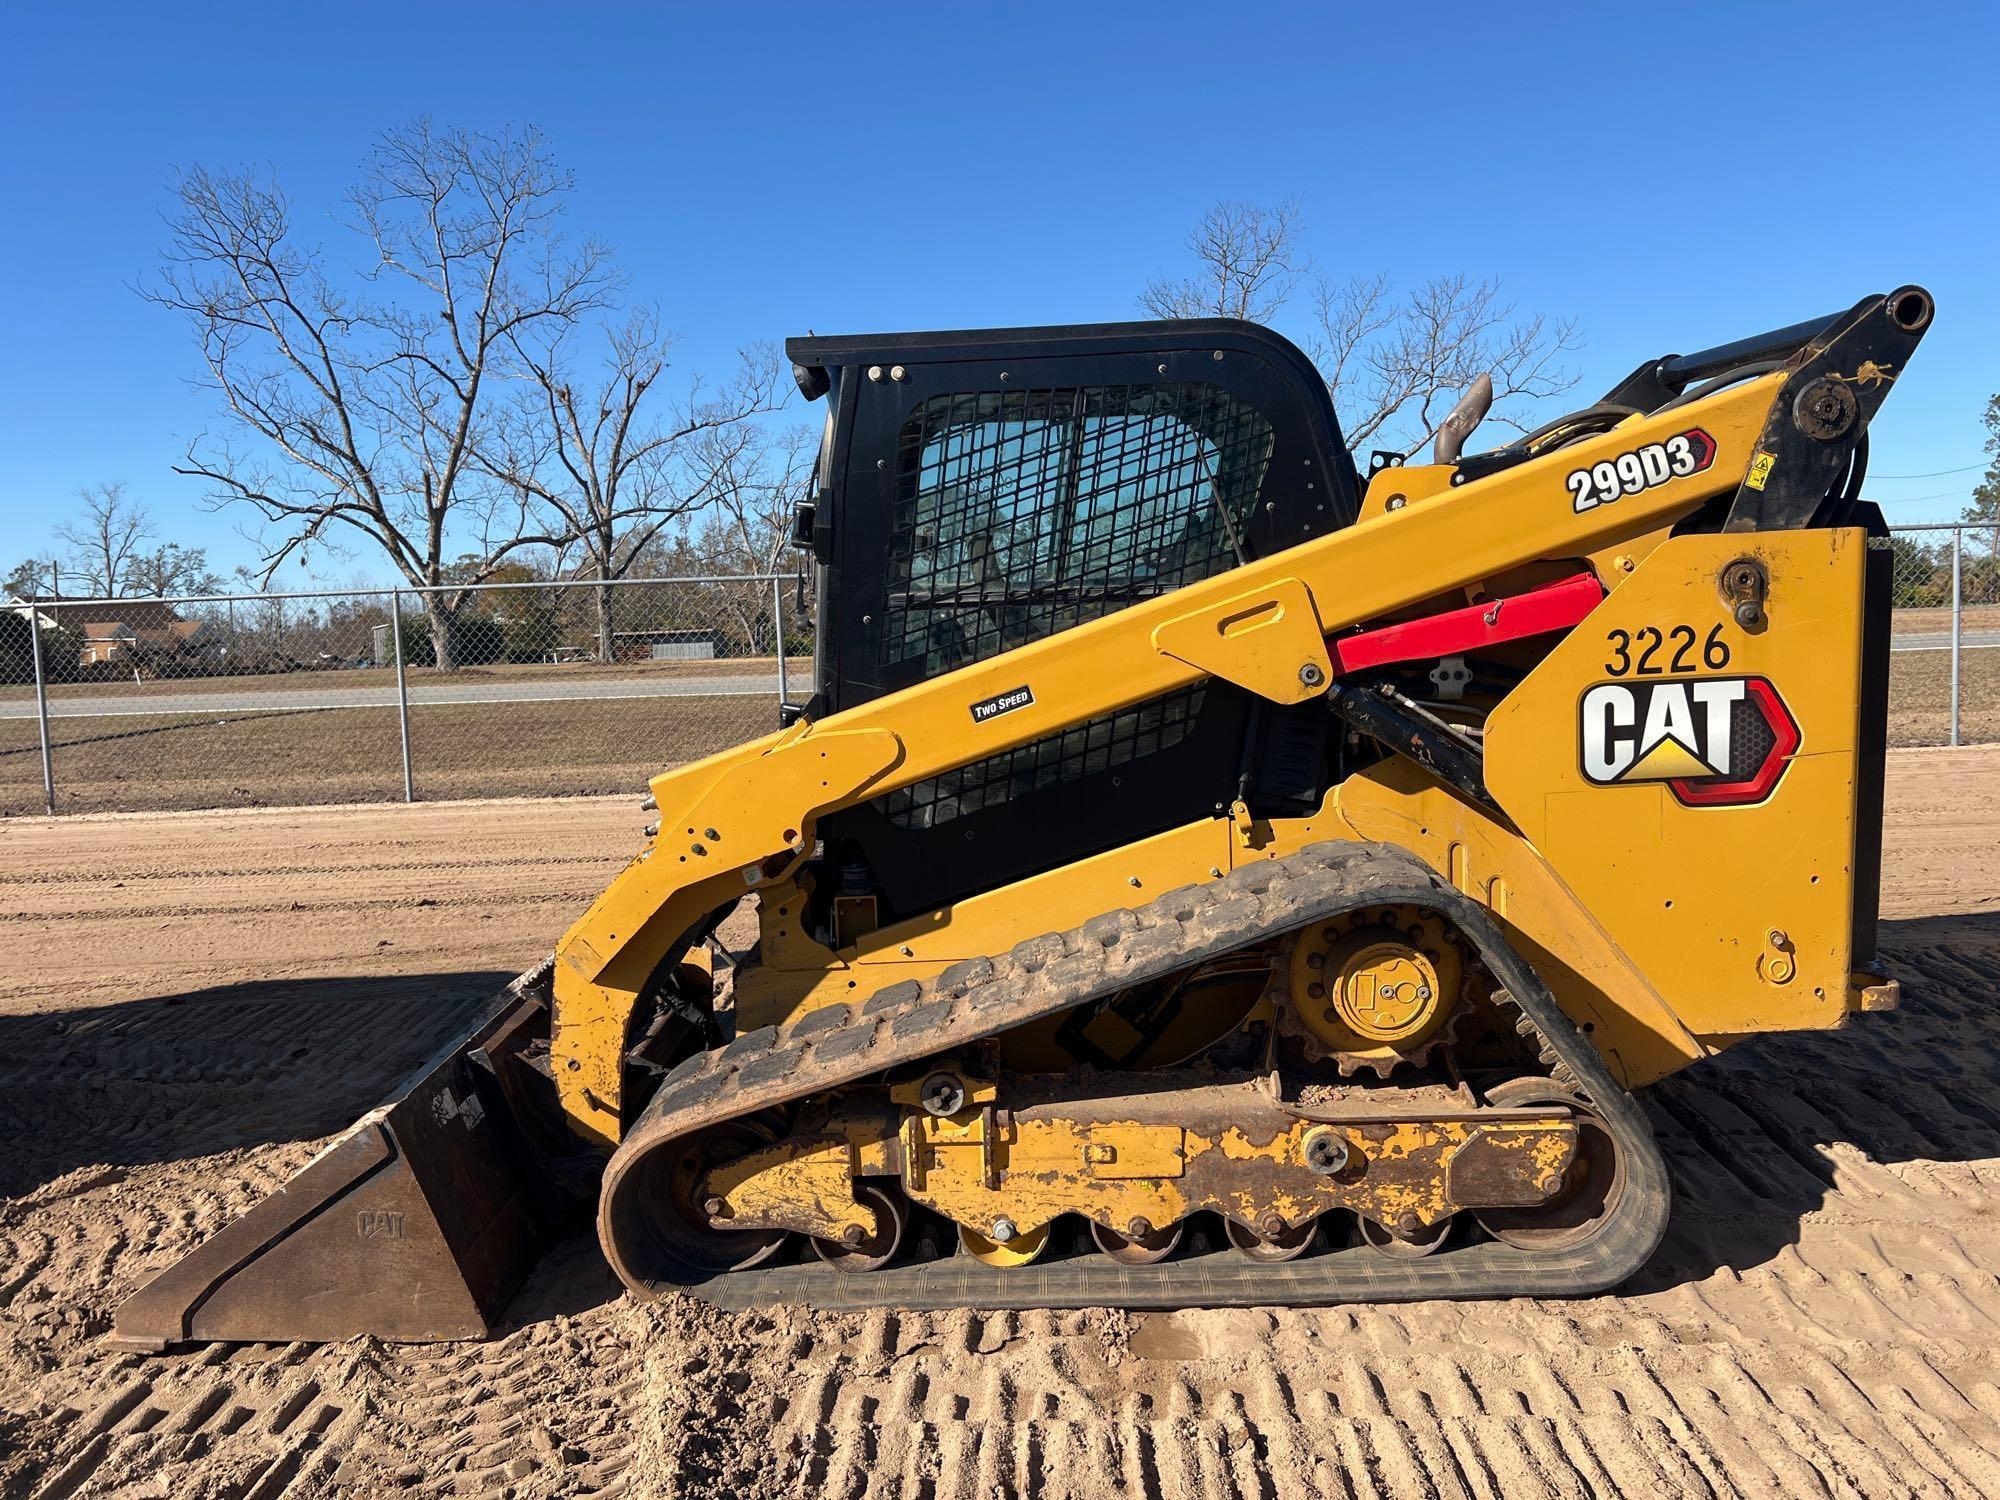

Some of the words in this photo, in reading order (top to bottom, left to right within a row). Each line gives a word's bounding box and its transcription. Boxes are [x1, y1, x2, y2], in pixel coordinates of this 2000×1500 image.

[1568, 436, 1695, 511] 299D3
[1605, 622, 1730, 677] 3226
[975, 703, 997, 718] TWO
[998, 691, 1028, 710] SPEED
[1583, 679, 1745, 781] CAT
[357, 1210, 405, 1238] CAT
